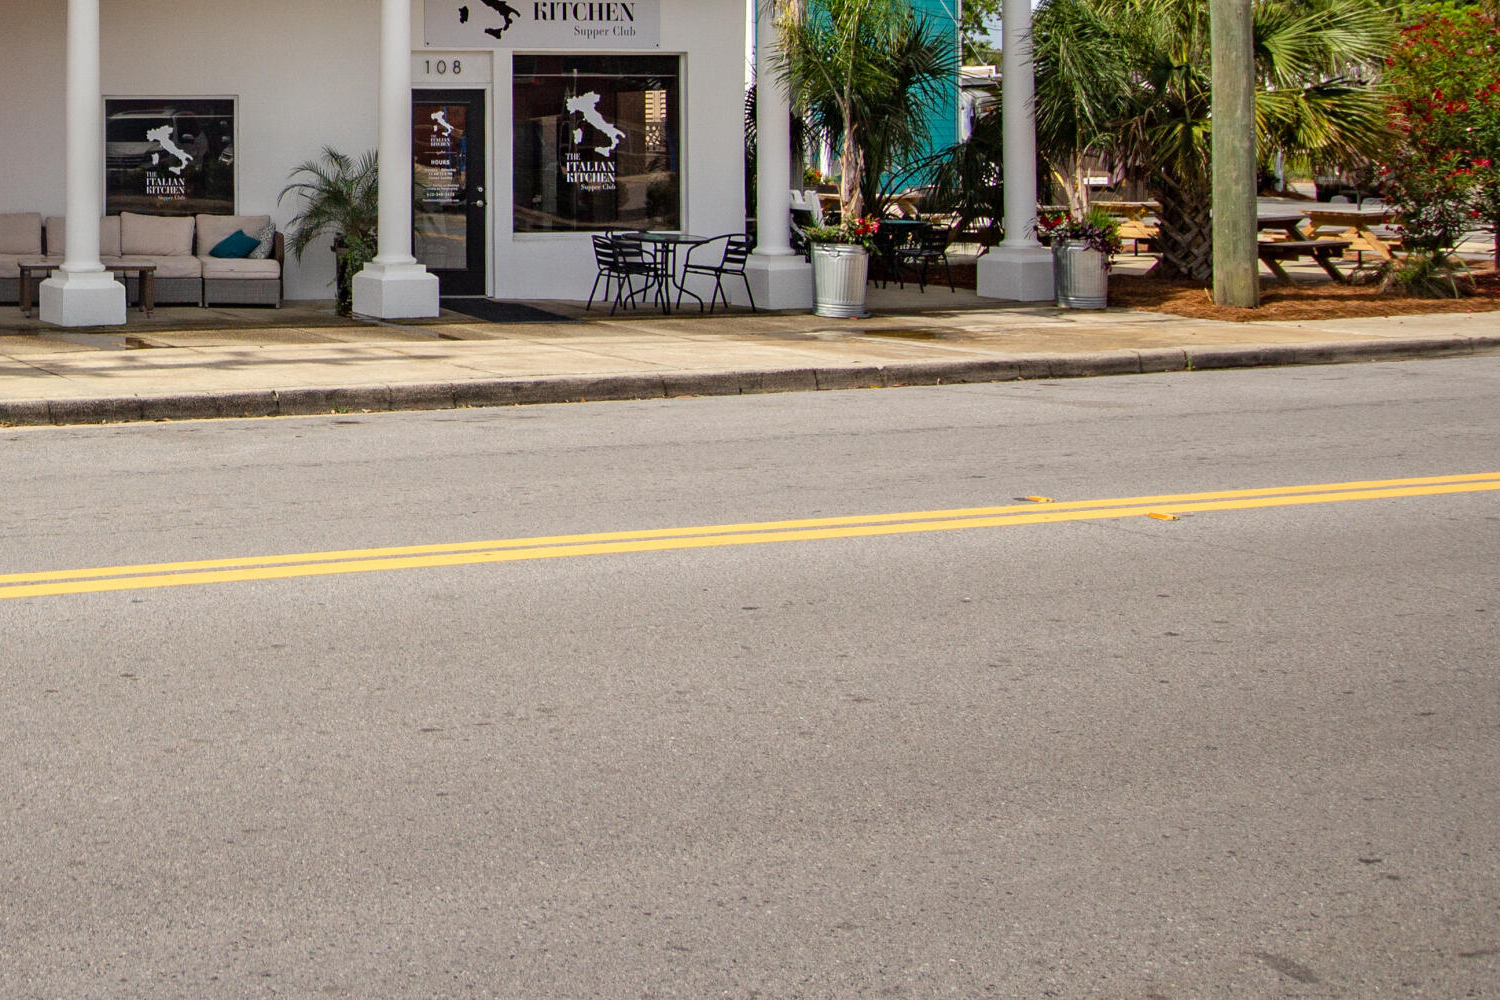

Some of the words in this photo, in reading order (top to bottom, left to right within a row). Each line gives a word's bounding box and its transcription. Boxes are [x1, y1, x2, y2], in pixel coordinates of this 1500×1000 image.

[533, 2, 635, 21] KITCHEN
[573, 25, 609, 39] Supper
[612, 25, 636, 36] Club
[425, 60, 461, 74] 108
[566, 153, 580, 161] THE
[566, 162, 616, 172] ITALIAN
[146, 178, 185, 186] ITALIAN
[566, 173, 616, 183] KITCHEN
[146, 186, 185, 194] KITCHEN
